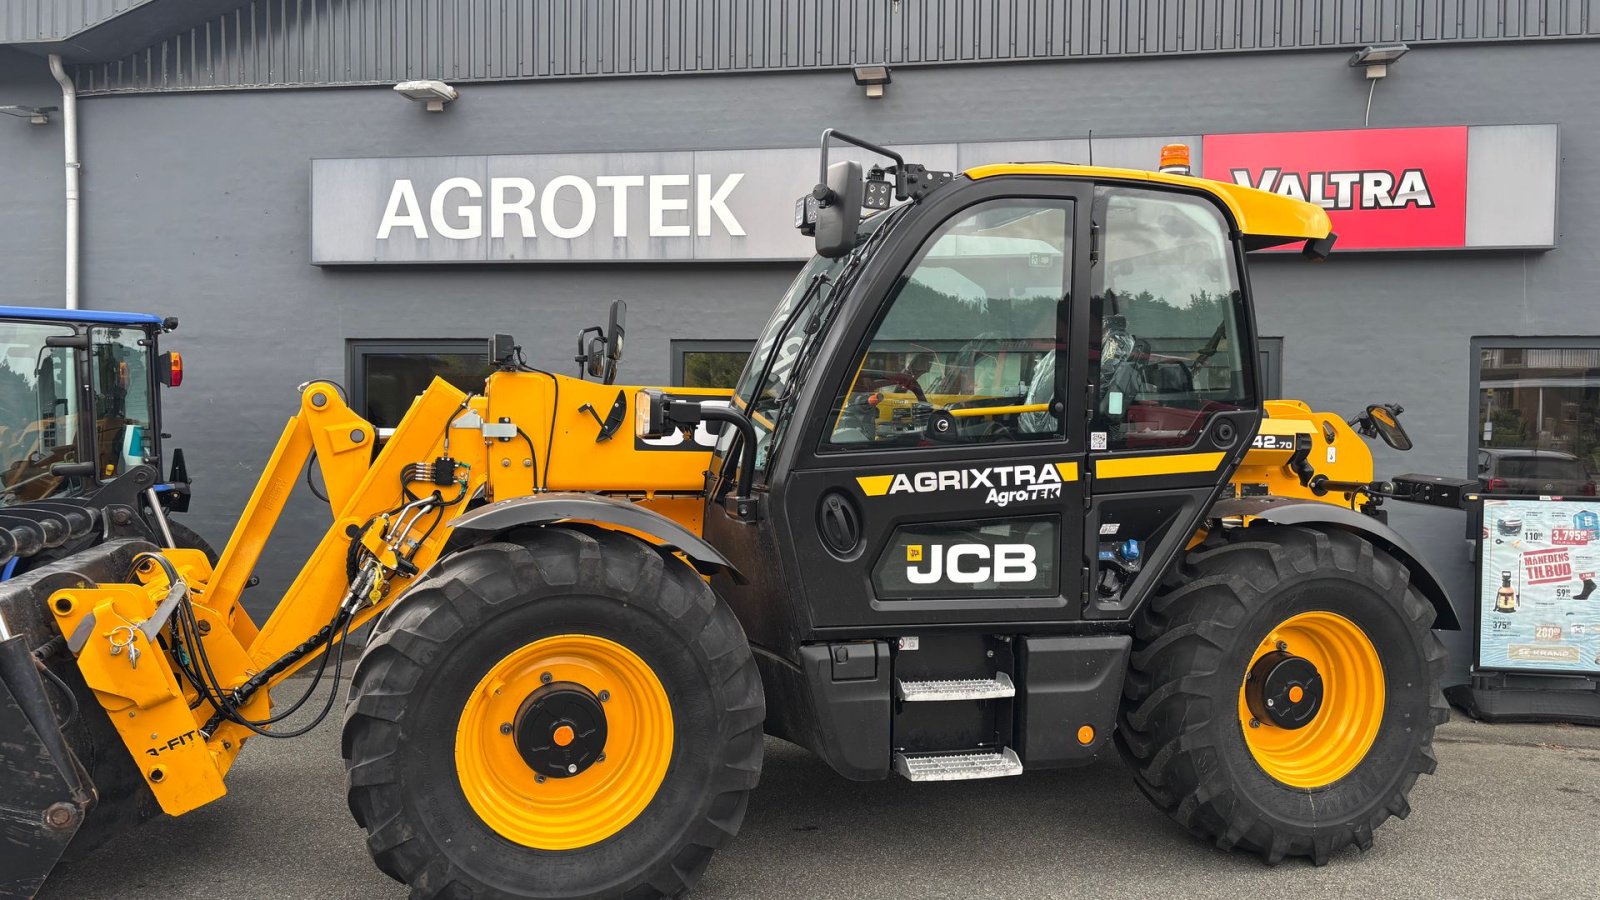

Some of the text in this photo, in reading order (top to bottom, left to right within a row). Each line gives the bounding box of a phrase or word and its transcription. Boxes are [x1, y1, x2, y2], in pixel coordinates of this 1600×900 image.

[376, 173, 747, 240] AGROTEK
[1230, 167, 1435, 210] VALTRA
[889, 464, 1062, 494] AGRIXTRA
[907, 544, 1037, 584] JCB
[1526, 563, 1571, 579] TILBUD
